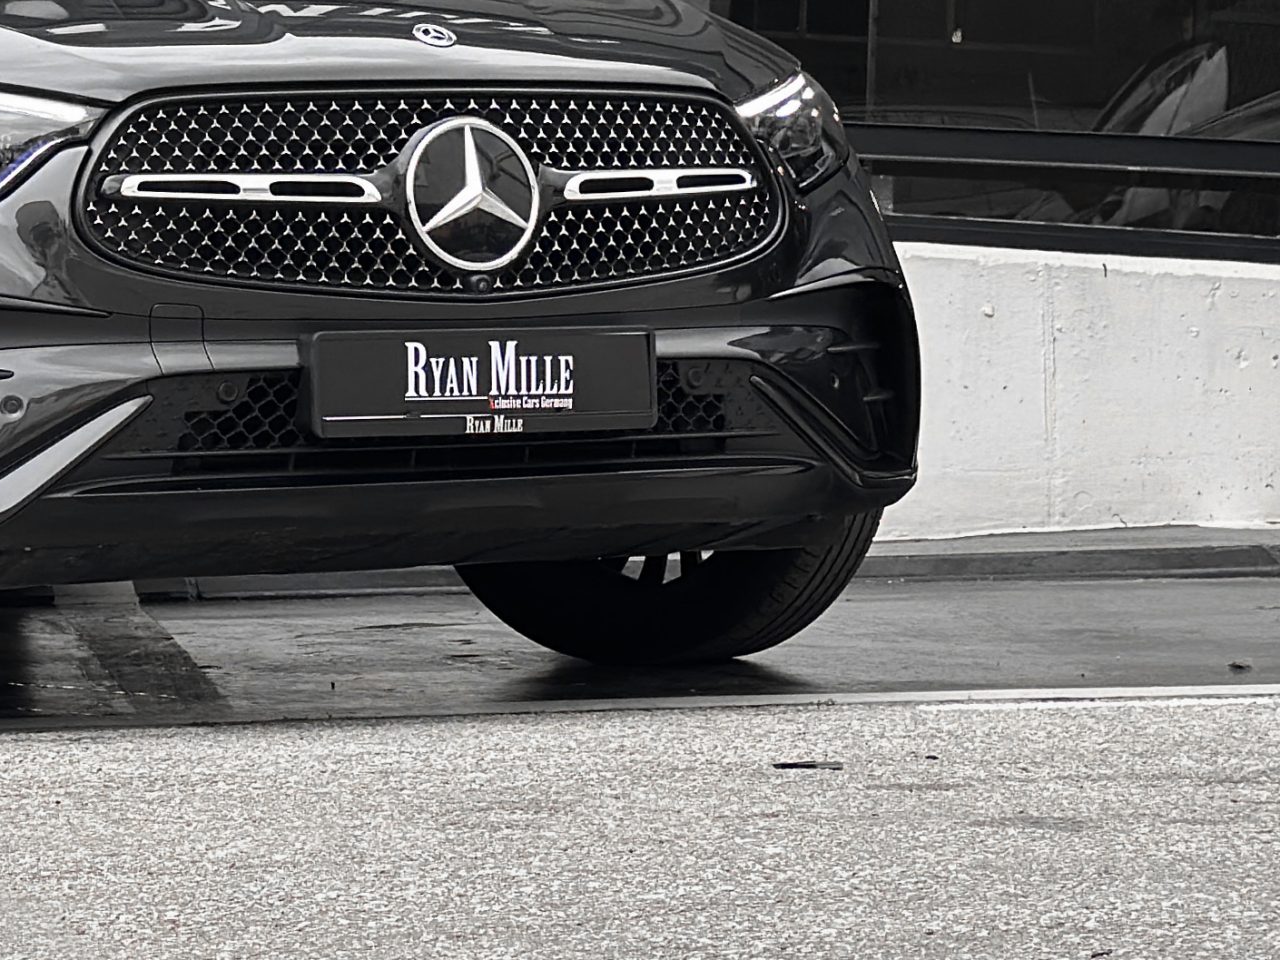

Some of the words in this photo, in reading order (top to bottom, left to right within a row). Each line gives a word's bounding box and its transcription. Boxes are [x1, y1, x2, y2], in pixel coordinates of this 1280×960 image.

[404, 341, 478, 397] RYAN
[488, 340, 574, 396] MILLE
[522, 396, 540, 409] Cars
[464, 416, 491, 434] RYAN
[493, 415, 524, 433] MILLE
